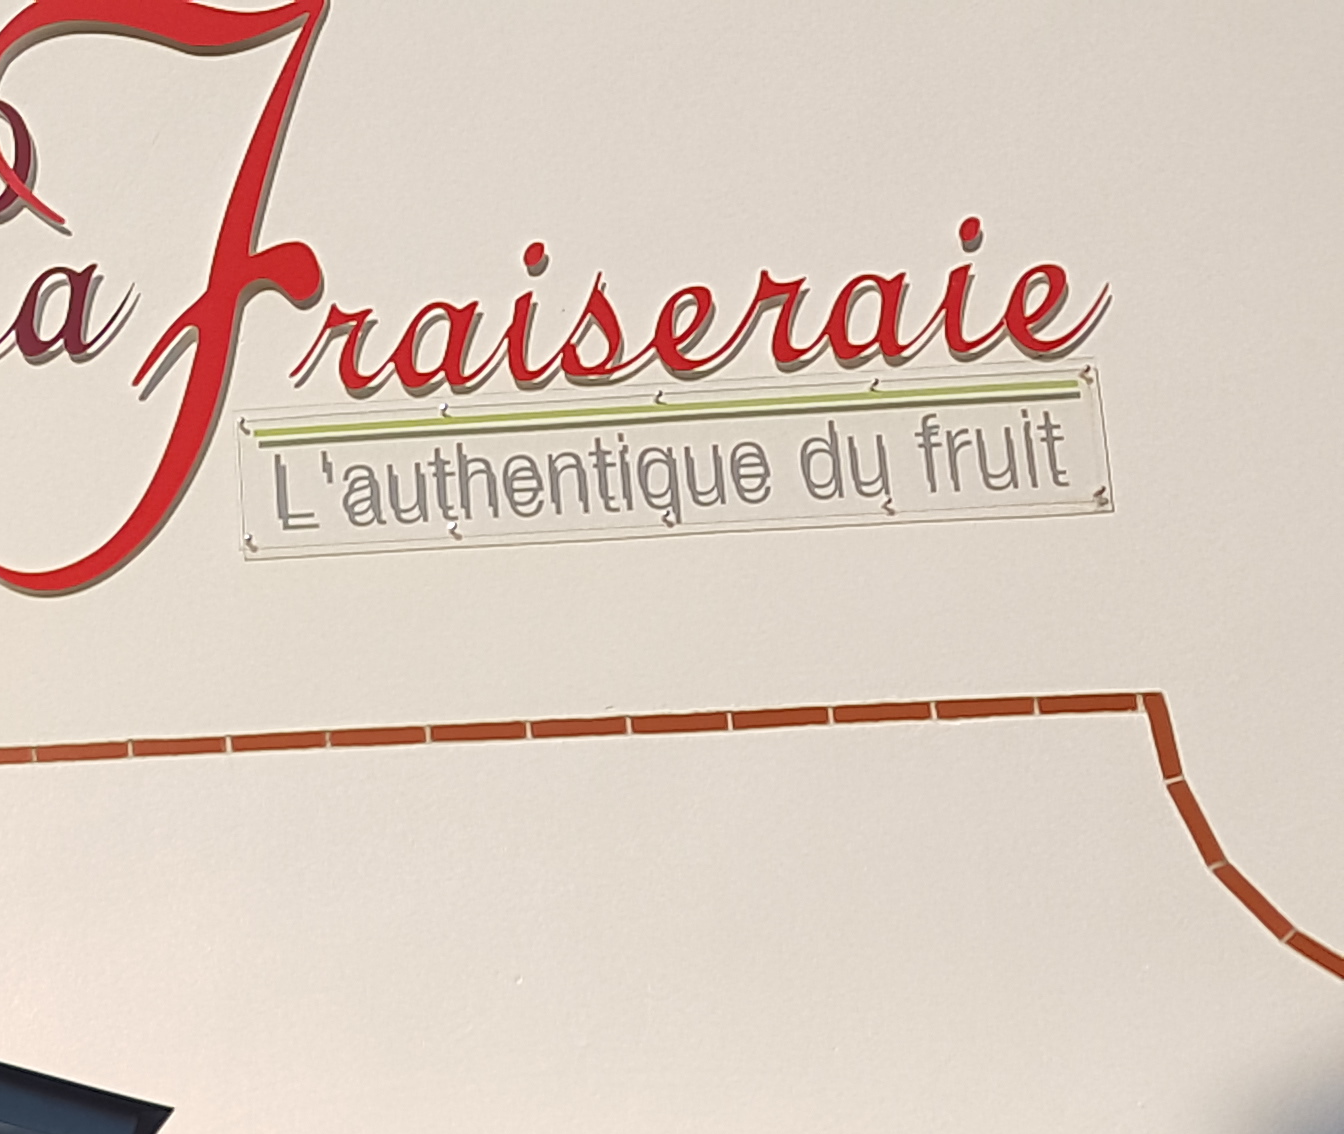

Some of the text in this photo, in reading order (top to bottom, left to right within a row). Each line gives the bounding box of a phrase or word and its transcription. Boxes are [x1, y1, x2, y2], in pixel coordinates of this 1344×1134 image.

[274, 408, 1071, 530] L'authentique du fruit
